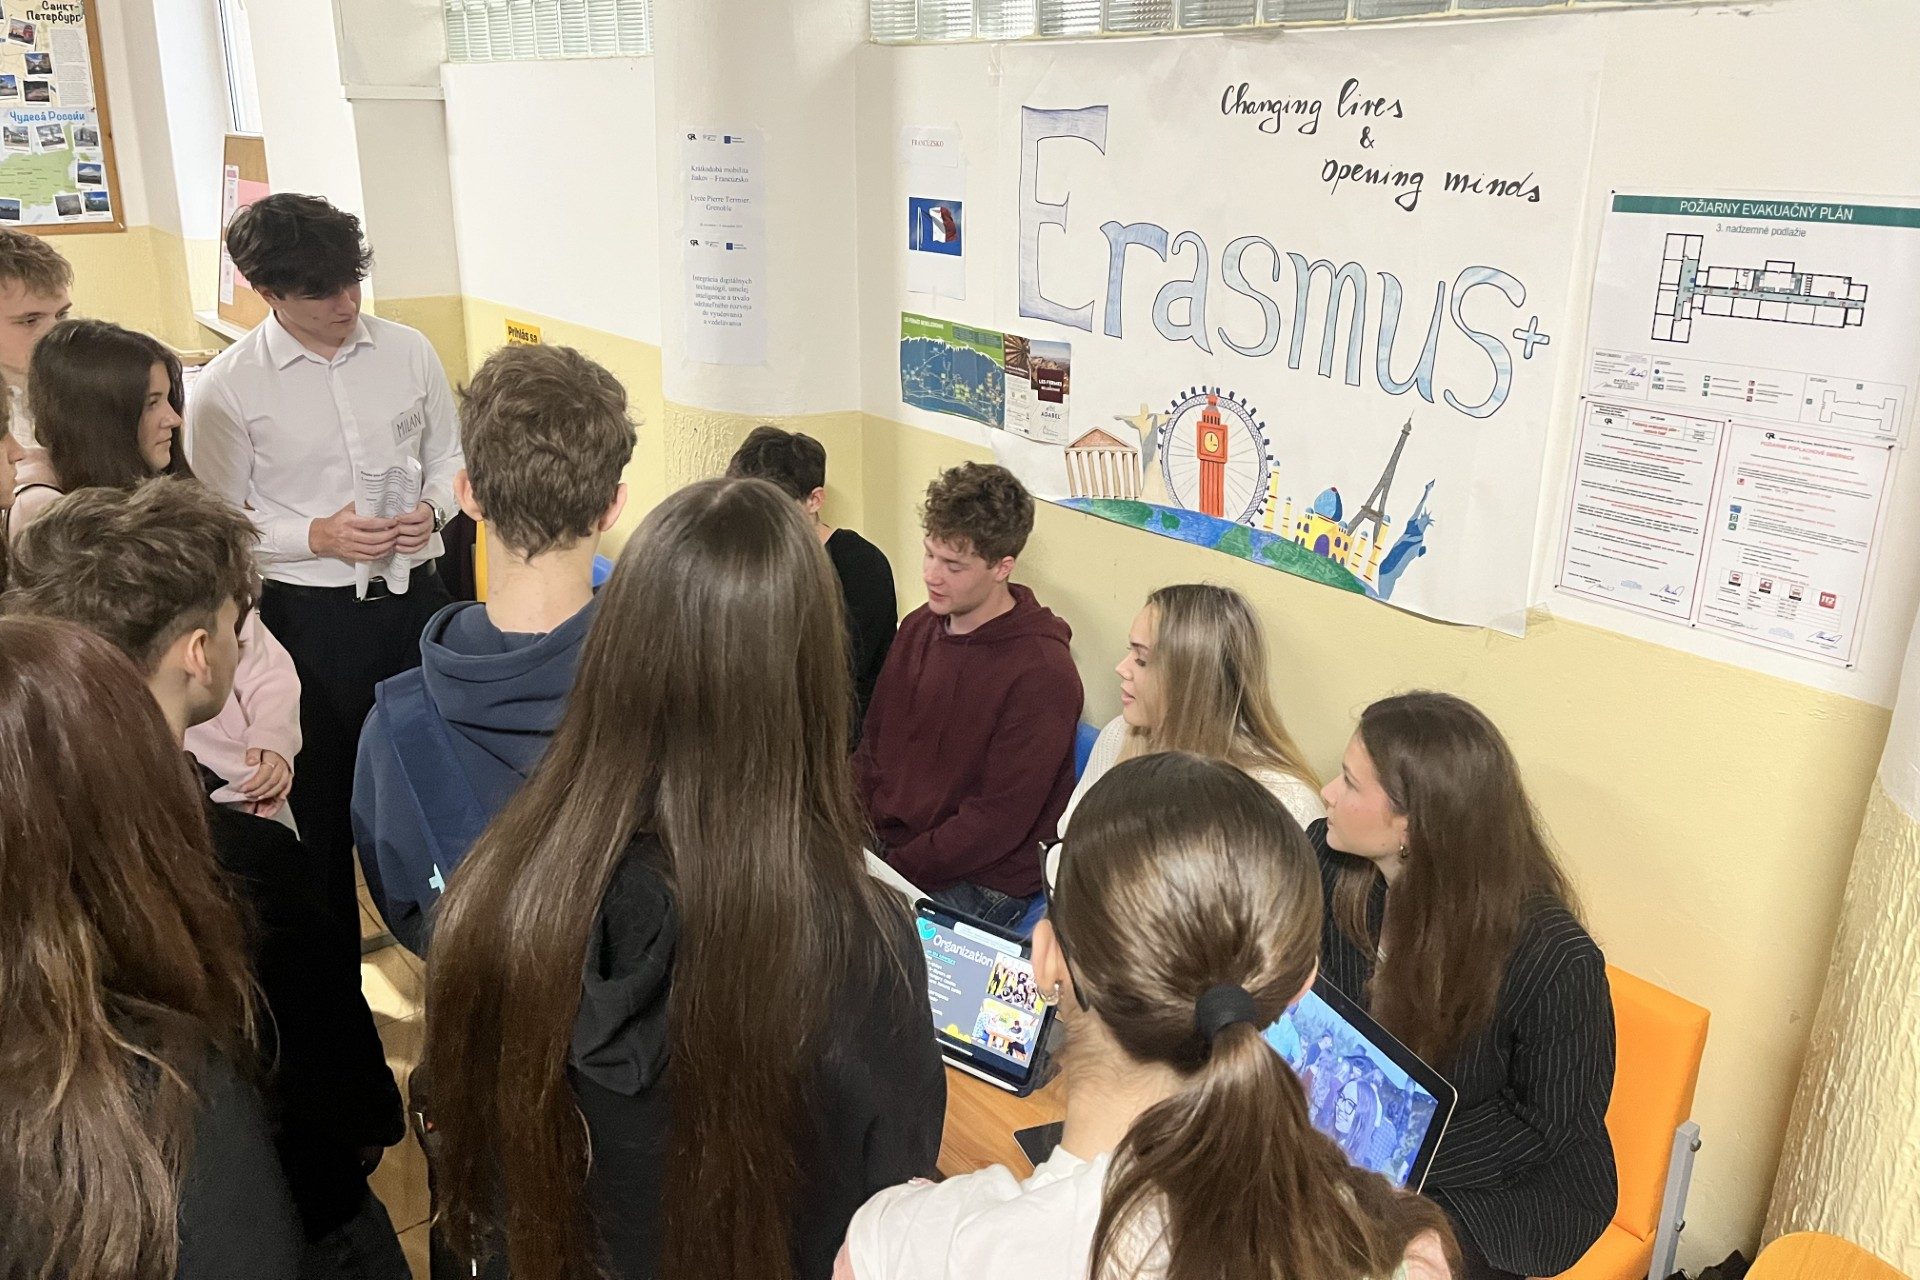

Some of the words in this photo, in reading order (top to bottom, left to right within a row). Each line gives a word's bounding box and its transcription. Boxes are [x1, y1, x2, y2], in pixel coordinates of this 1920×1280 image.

[26, 10, 83, 24] Петербург
[42, 1, 79, 10] Санкт-
[1221, 83, 1322, 134] Changing
[1338, 78, 1404, 119] lives
[1359, 126, 1376, 149] &
[1443, 171, 1541, 203] minds
[1680, 198, 1740, 214] POŽIARNY
[1742, 202, 1816, 219] EVAKUAČNÝ
[1820, 206, 1853, 221] PLÁN
[1716, 223, 1724, 233] 3.
[1726, 225, 1769, 236] nadzemné
[1771, 228, 1807, 238] podlažie
[1019, 104, 1550, 419] Erasmus+
[397, 412, 421, 438] MILAN
[933, 934, 994, 967] Organization
